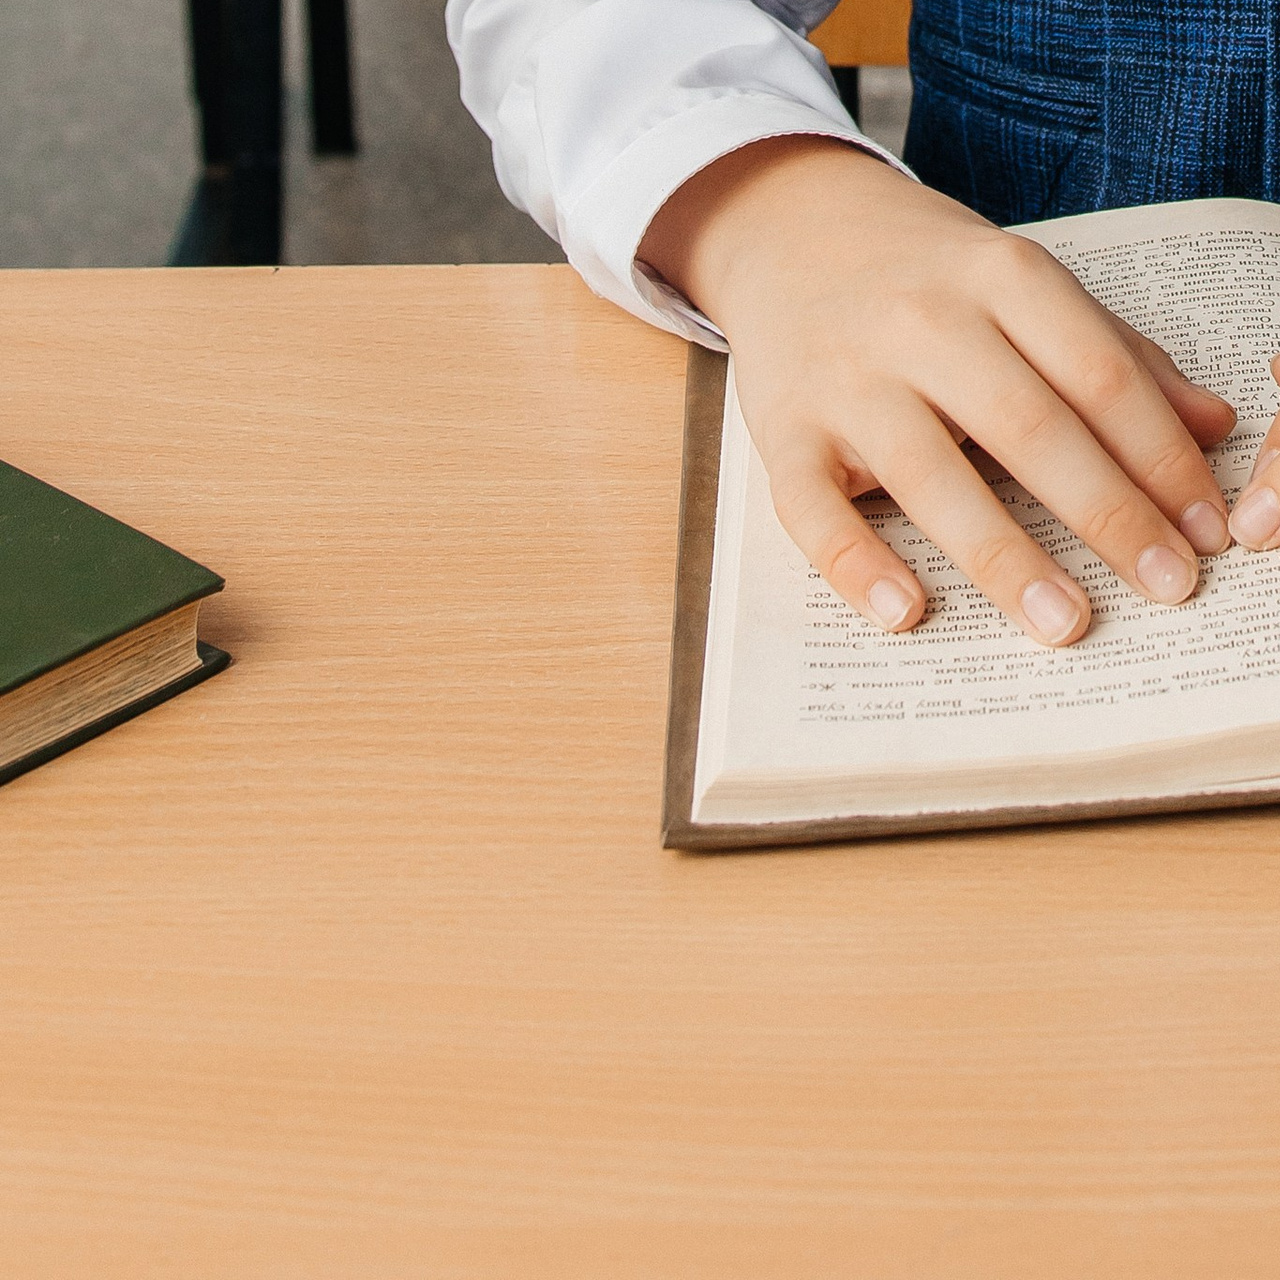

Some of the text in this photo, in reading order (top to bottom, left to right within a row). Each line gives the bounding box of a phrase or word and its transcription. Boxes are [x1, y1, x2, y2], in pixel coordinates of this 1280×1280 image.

[1160, 233, 1192, 245] этой
[1197, 230, 1214, 238] от
[1054, 240, 1074, 249] 157
[1076, 239, 1155, 258] несчастной
[1084, 237, 1263, 264] Именем сказала
[1143, 249, 1181, 261] из-за
[1144, 259, 1173, 268] Это
[1179, 252, 1237, 265] смерти?
[1099, 265, 1137, 276] из-за
[1153, 261, 1231, 275] собираться
[1159, 283, 1176, 291] за
[1182, 277, 1226, 287] казни
[1133, 295, 1149, 303] по
[1156, 292, 1245, 308] послышался
[1163, 314, 1195, 323] Там
[1208, 315, 1272, 326] Она это
[1162, 332, 1190, 341] моя
[1196, 327, 1226, 336] Это
[1204, 345, 1222, 353] не
[1178, 352, 1242, 365] мой! Вы
[1228, 359, 1261, 370] мне!
[1189, 367, 1267, 382] спасешься
[1242, 376, 1271, 384] моя
[1238, 387, 1265, 395] что
[1221, 557, 1270, 570] опять
[1217, 572, 1244, 582] эти
[1149, 601, 1208, 618] кричал
[804, 622, 850, 630] иска-
[910, 622, 989, 635] смертной
[1200, 620, 1226, 631] где
[1145, 626, 1192, 640] стоял
[1187, 636, 1204, 644] ее
[804, 641, 865, 652] Элоиза
[1179, 639, 1255, 657] королева
[953, 648, 1056, 664] послышался
[1065, 644, 1156, 663] прижалась
[897, 658, 943, 667] голос
[1006, 661, 1035, 671] ней
[1082, 652, 1171, 673] протянула
